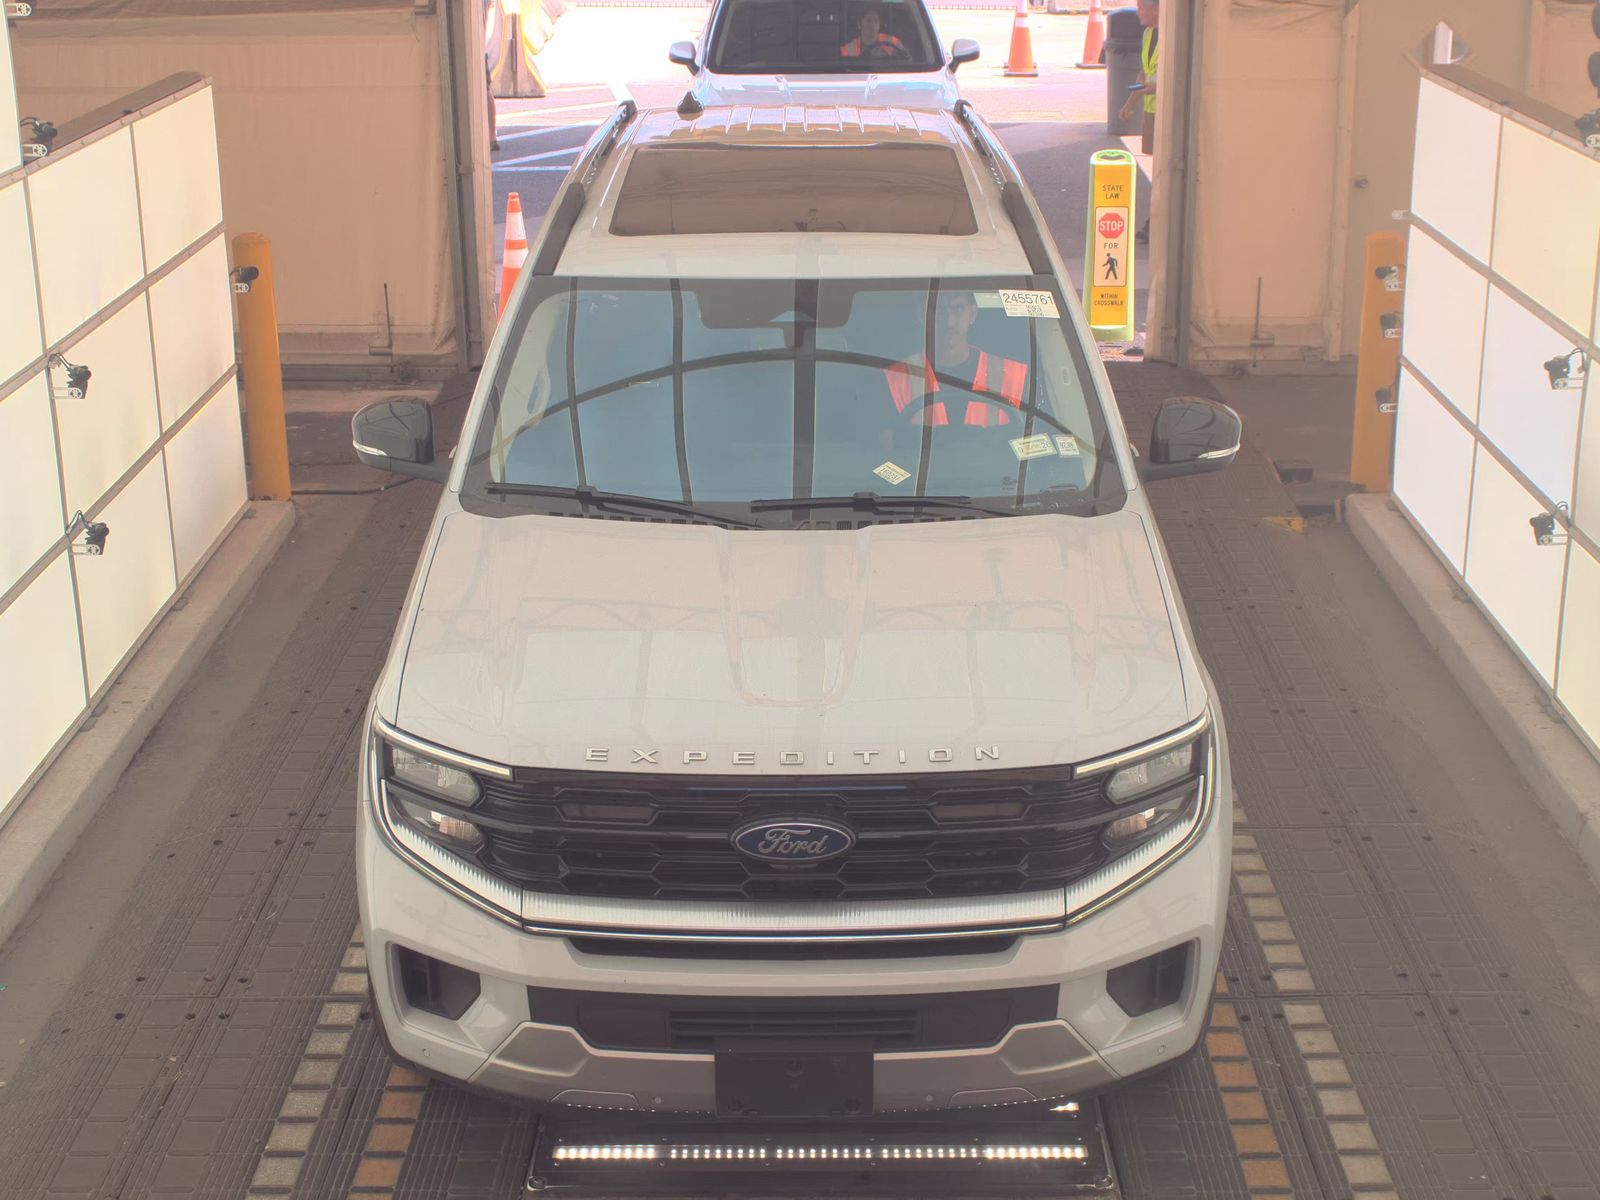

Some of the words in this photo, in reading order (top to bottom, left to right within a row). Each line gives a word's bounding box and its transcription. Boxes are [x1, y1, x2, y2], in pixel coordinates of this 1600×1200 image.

[1099, 220, 1124, 231] STOP
[1002, 293, 1054, 305] 2455761
[585, 745, 1001, 765] EXPEDITION
[758, 828, 829, 854] Ford
